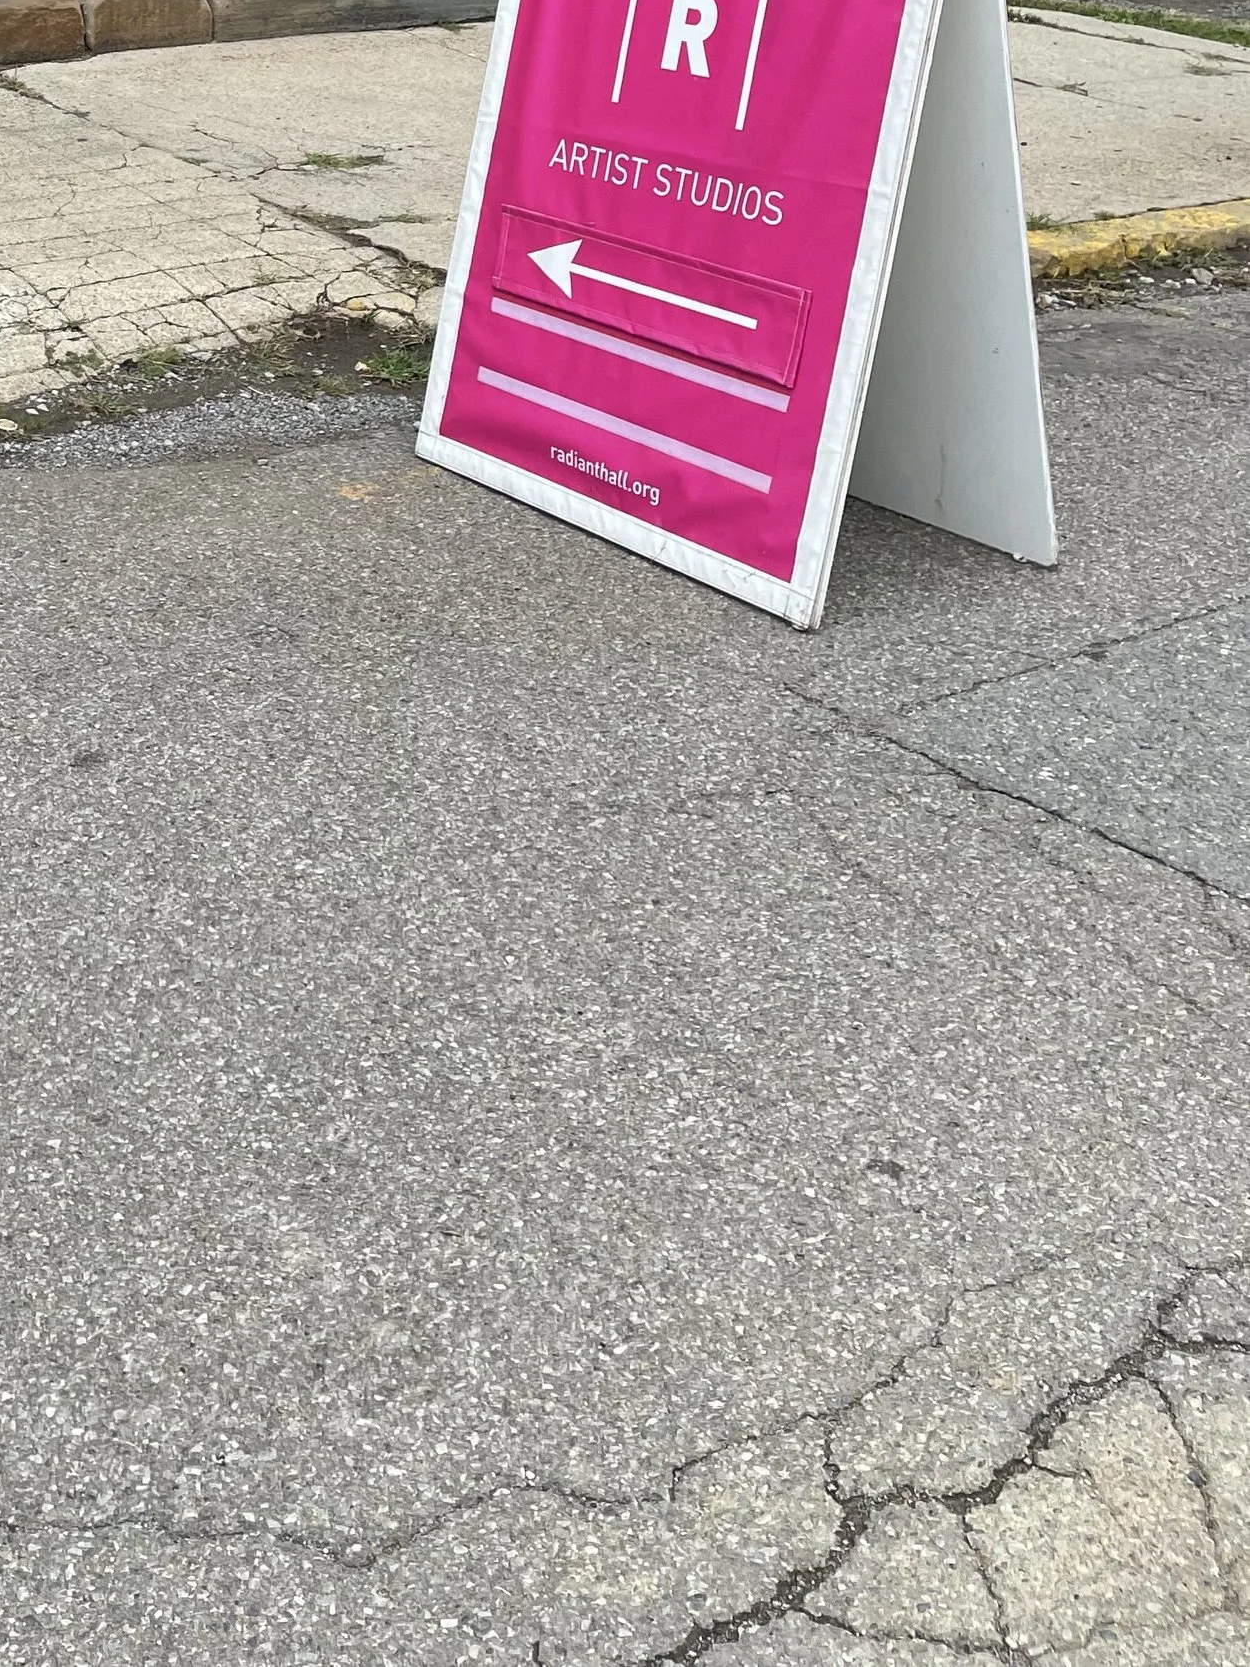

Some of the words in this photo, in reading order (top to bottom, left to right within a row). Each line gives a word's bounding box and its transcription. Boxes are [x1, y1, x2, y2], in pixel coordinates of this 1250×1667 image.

[548, 138, 649, 190] ARTIST
[652, 163, 785, 226] STUDIOS
[550, 446, 661, 506] radianthall.org
